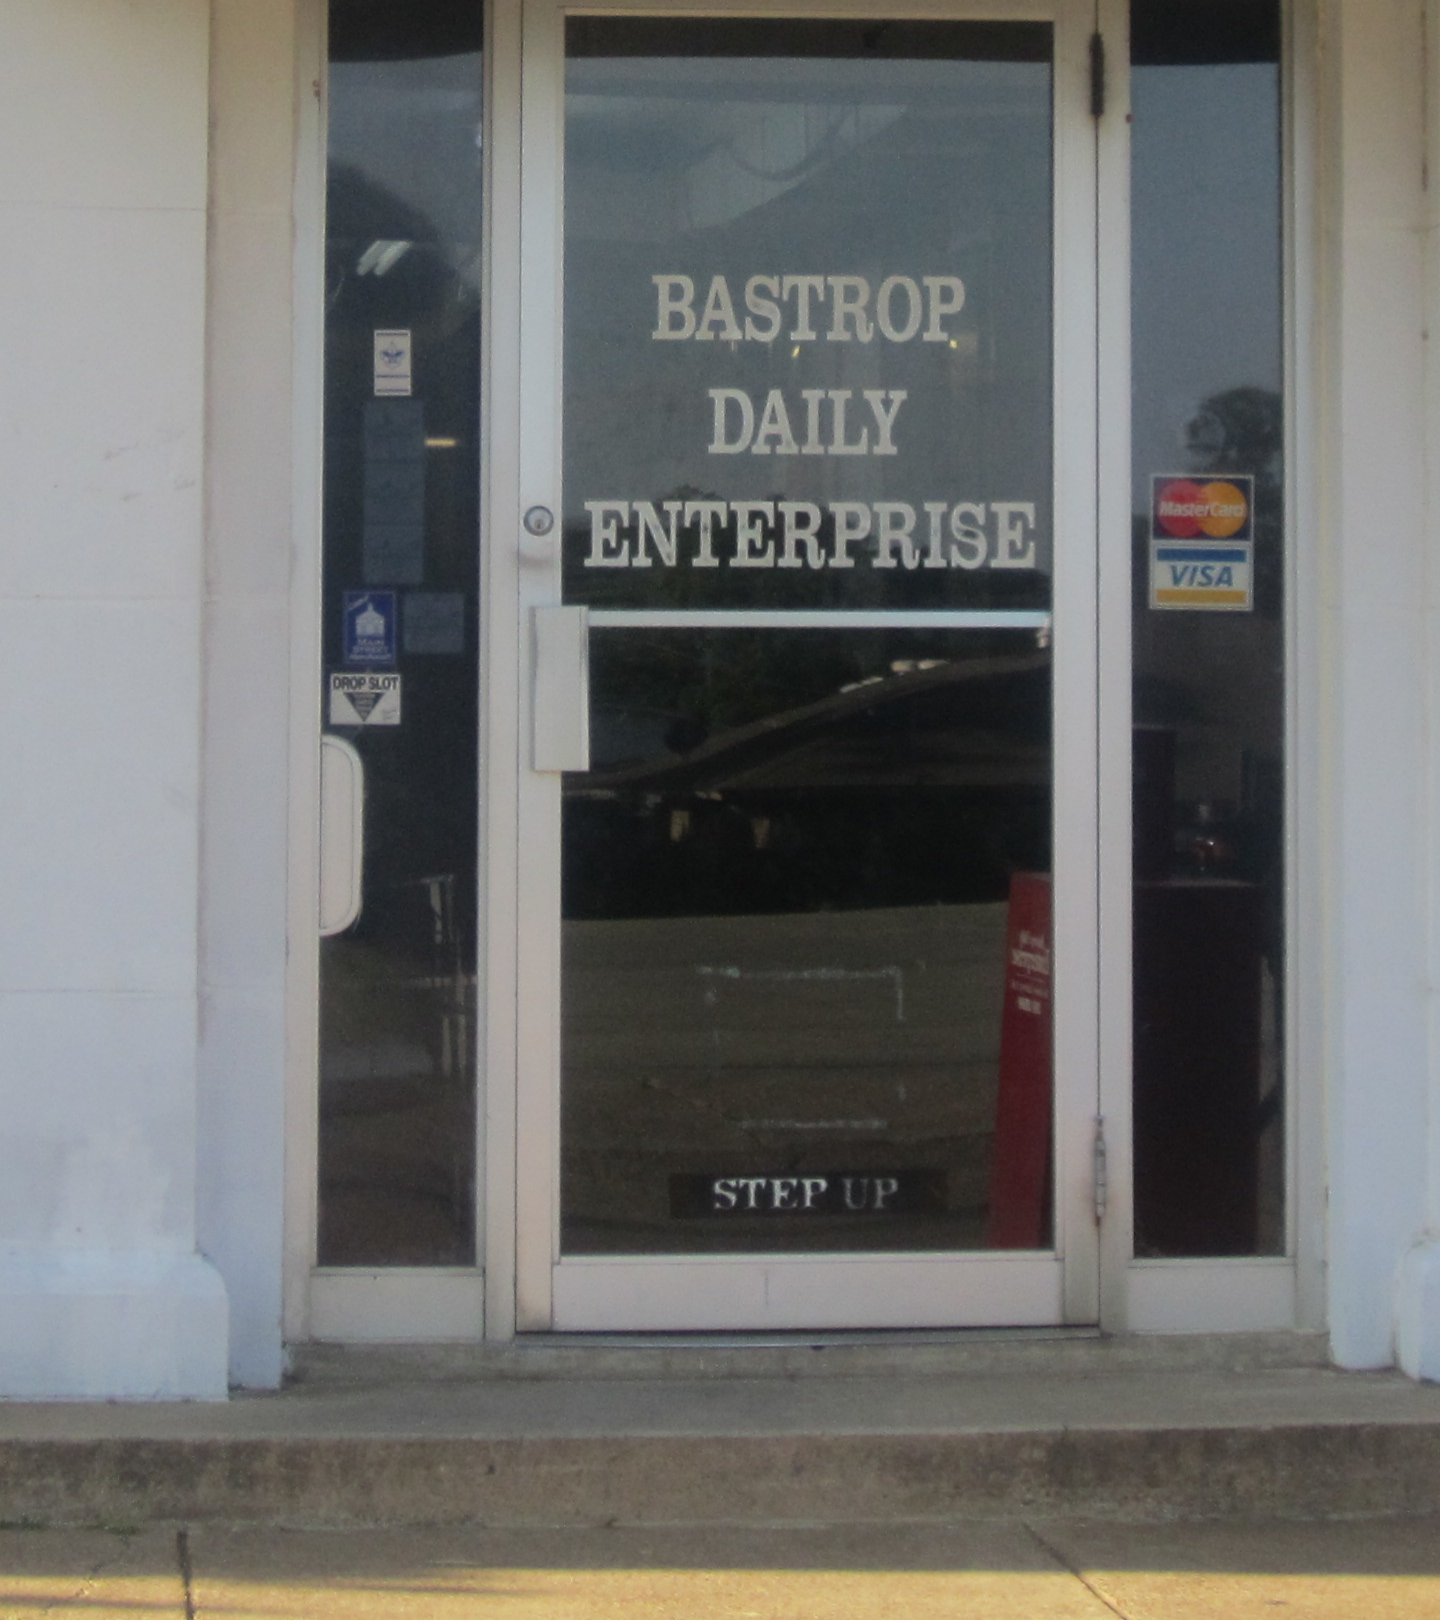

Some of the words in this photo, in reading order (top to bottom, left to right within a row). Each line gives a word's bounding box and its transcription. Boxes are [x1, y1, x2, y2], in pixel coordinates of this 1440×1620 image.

[652, 275, 965, 342] BASTROP
[708, 389, 907, 455] DAILY
[1160, 501, 1245, 518] MasterCard
[584, 501, 1035, 569] ENTERPRISE
[1169, 565, 1234, 587] VISA
[333, 676, 366, 690] DROP
[368, 677, 398, 690] SLOT
[713, 1177, 828, 1210] STEP
[842, 1178, 899, 1210] UP
